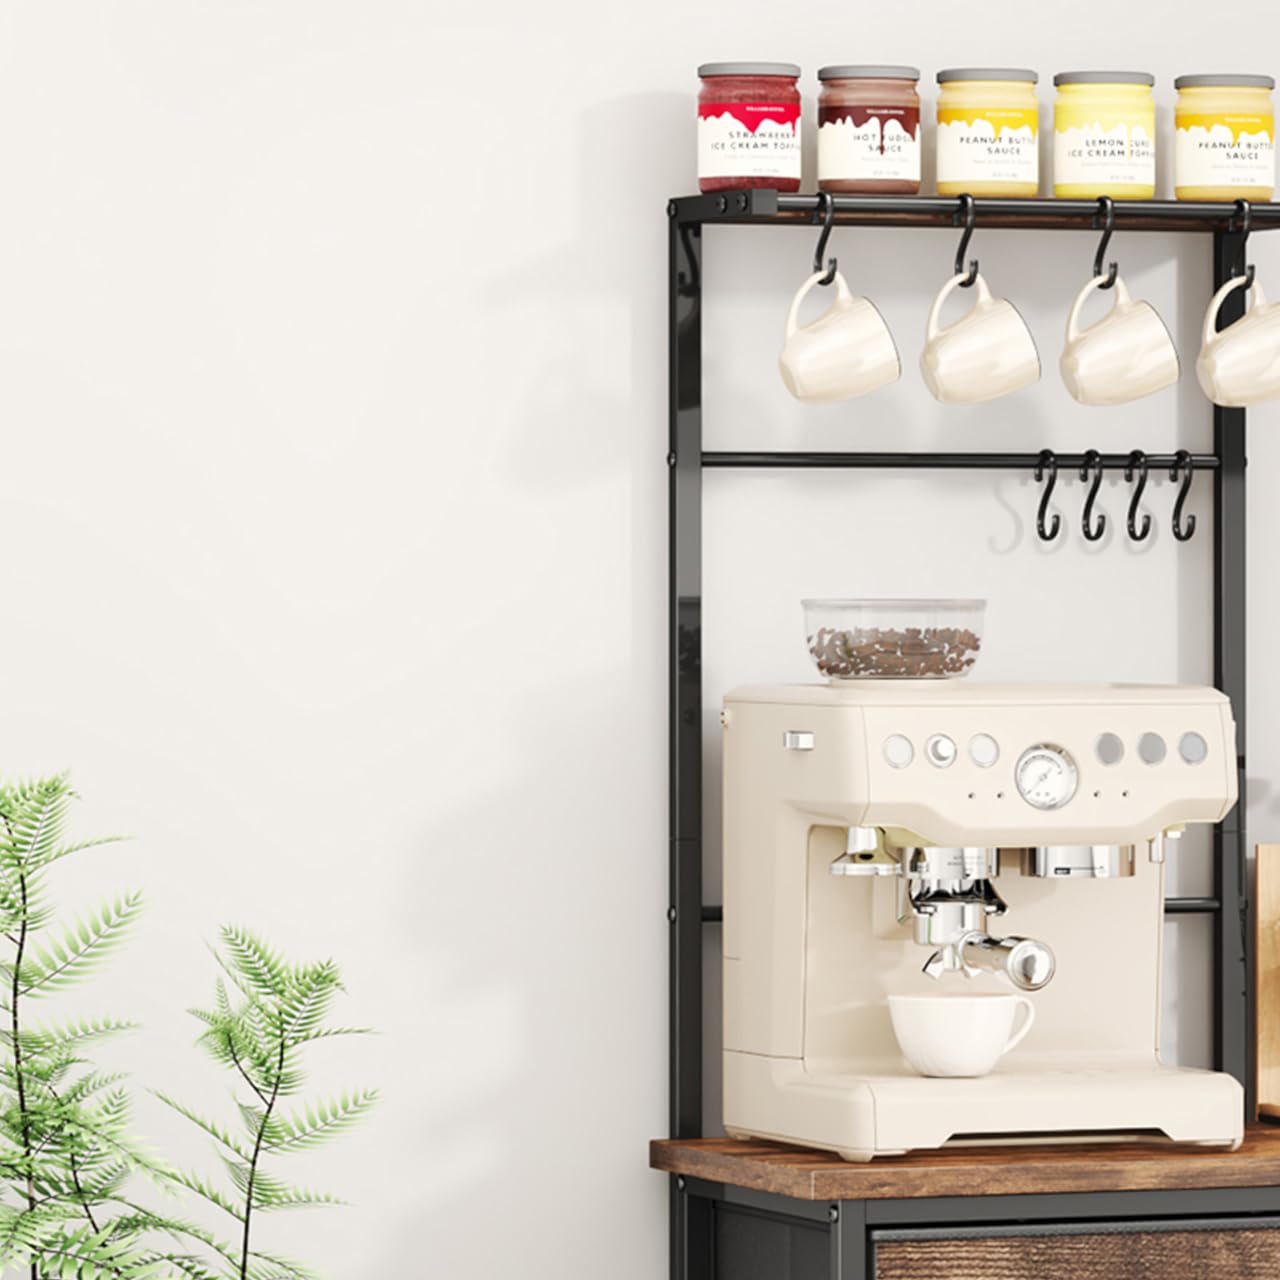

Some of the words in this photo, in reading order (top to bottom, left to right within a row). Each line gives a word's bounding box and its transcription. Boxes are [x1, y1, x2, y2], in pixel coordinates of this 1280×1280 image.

[728, 131, 795, 139] STRAWBERR
[1085, 139, 1124, 147] LEMON
[1087, 149, 1125, 157] CREAM
